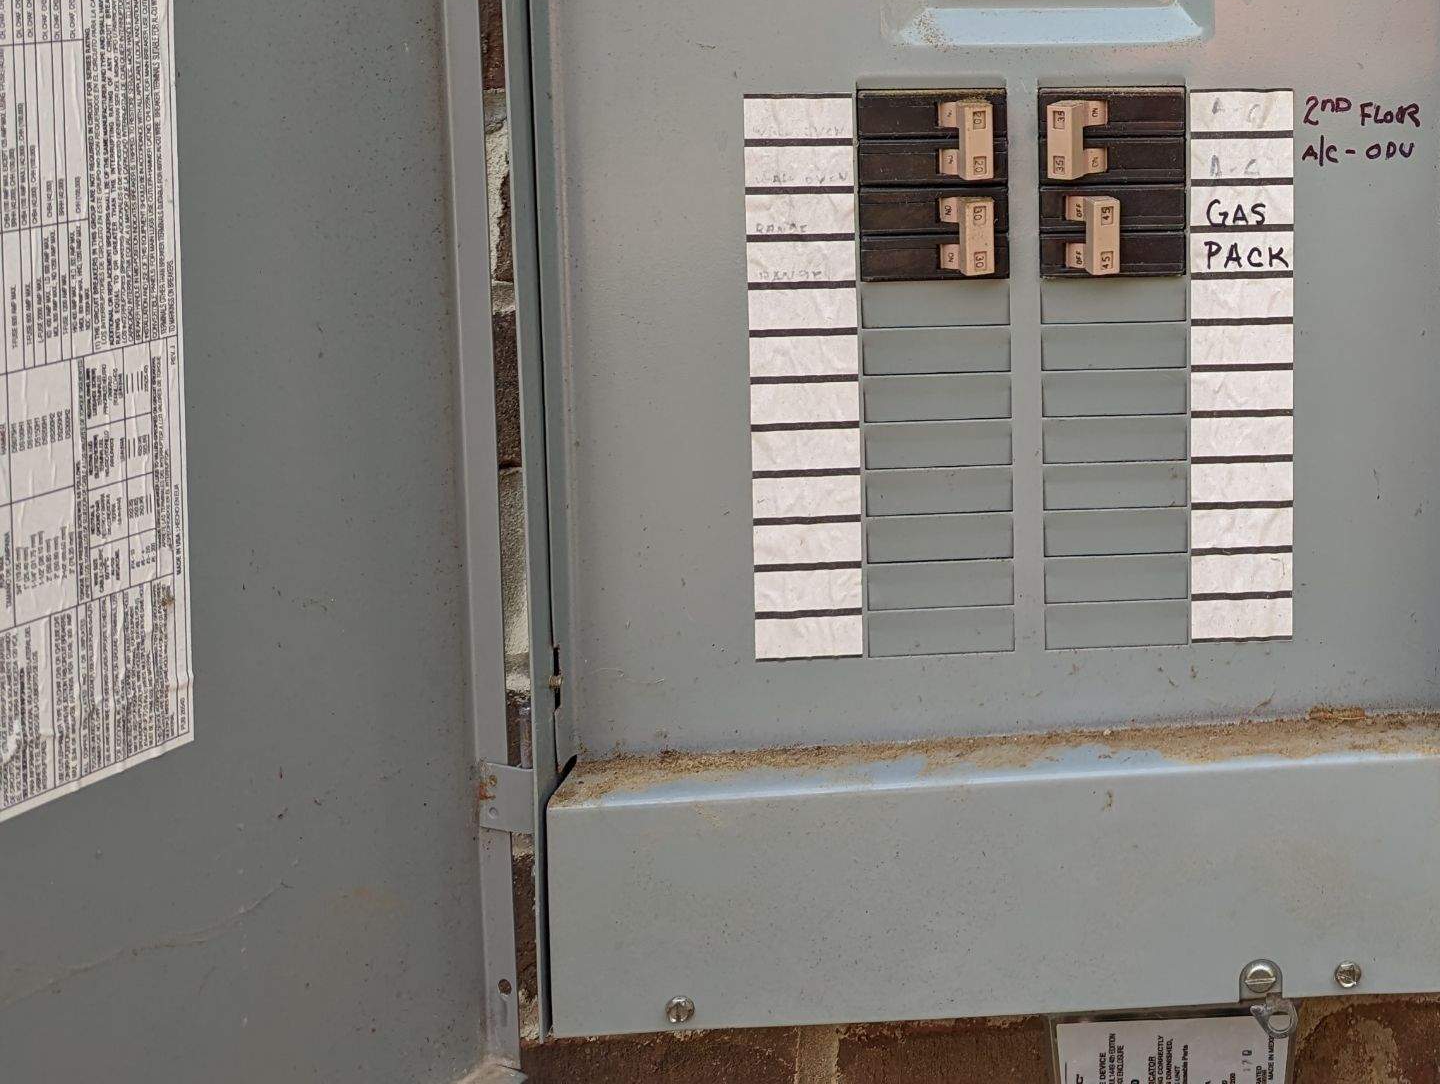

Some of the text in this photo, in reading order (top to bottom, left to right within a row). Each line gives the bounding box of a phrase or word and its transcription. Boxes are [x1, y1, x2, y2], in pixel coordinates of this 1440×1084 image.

[1057, 111, 1066, 122] 35
[1092, 108, 1098, 118] ON
[1360, 102, 1420, 127] FLOOR
[1302, 134, 1339, 166] A/C
[1365, 141, 1414, 160] ODU
[974, 160, 983, 173] 20
[1056, 160, 1064, 172] 35
[944, 205, 952, 216] ON
[974, 207, 982, 221] 30
[1206, 198, 1266, 228] GAS
[1204, 240, 1289, 269] PACK
[975, 255, 984, 268] 30
[1101, 256, 1110, 269] 45
[1166, 1039, 1174, 1080] DIMINISHED,
